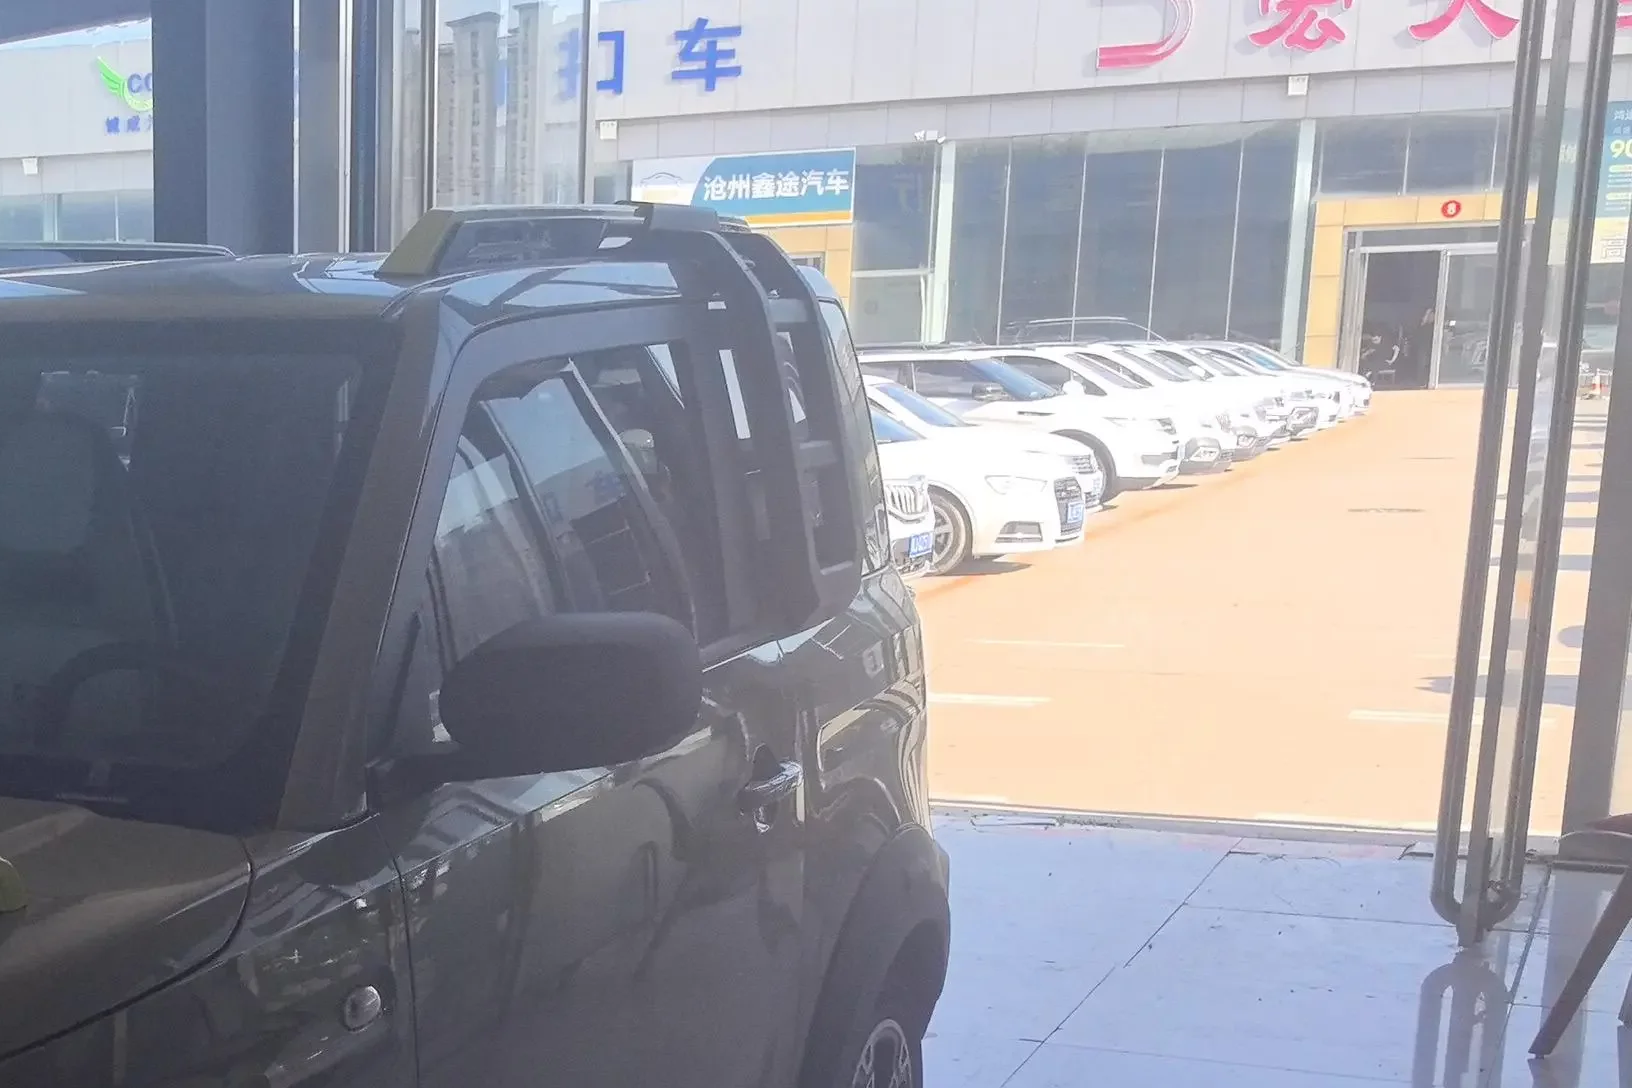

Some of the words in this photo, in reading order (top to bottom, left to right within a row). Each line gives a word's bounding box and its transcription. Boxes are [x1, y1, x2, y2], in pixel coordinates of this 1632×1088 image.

[703, 168, 850, 201] 沧州鑫途汽车
